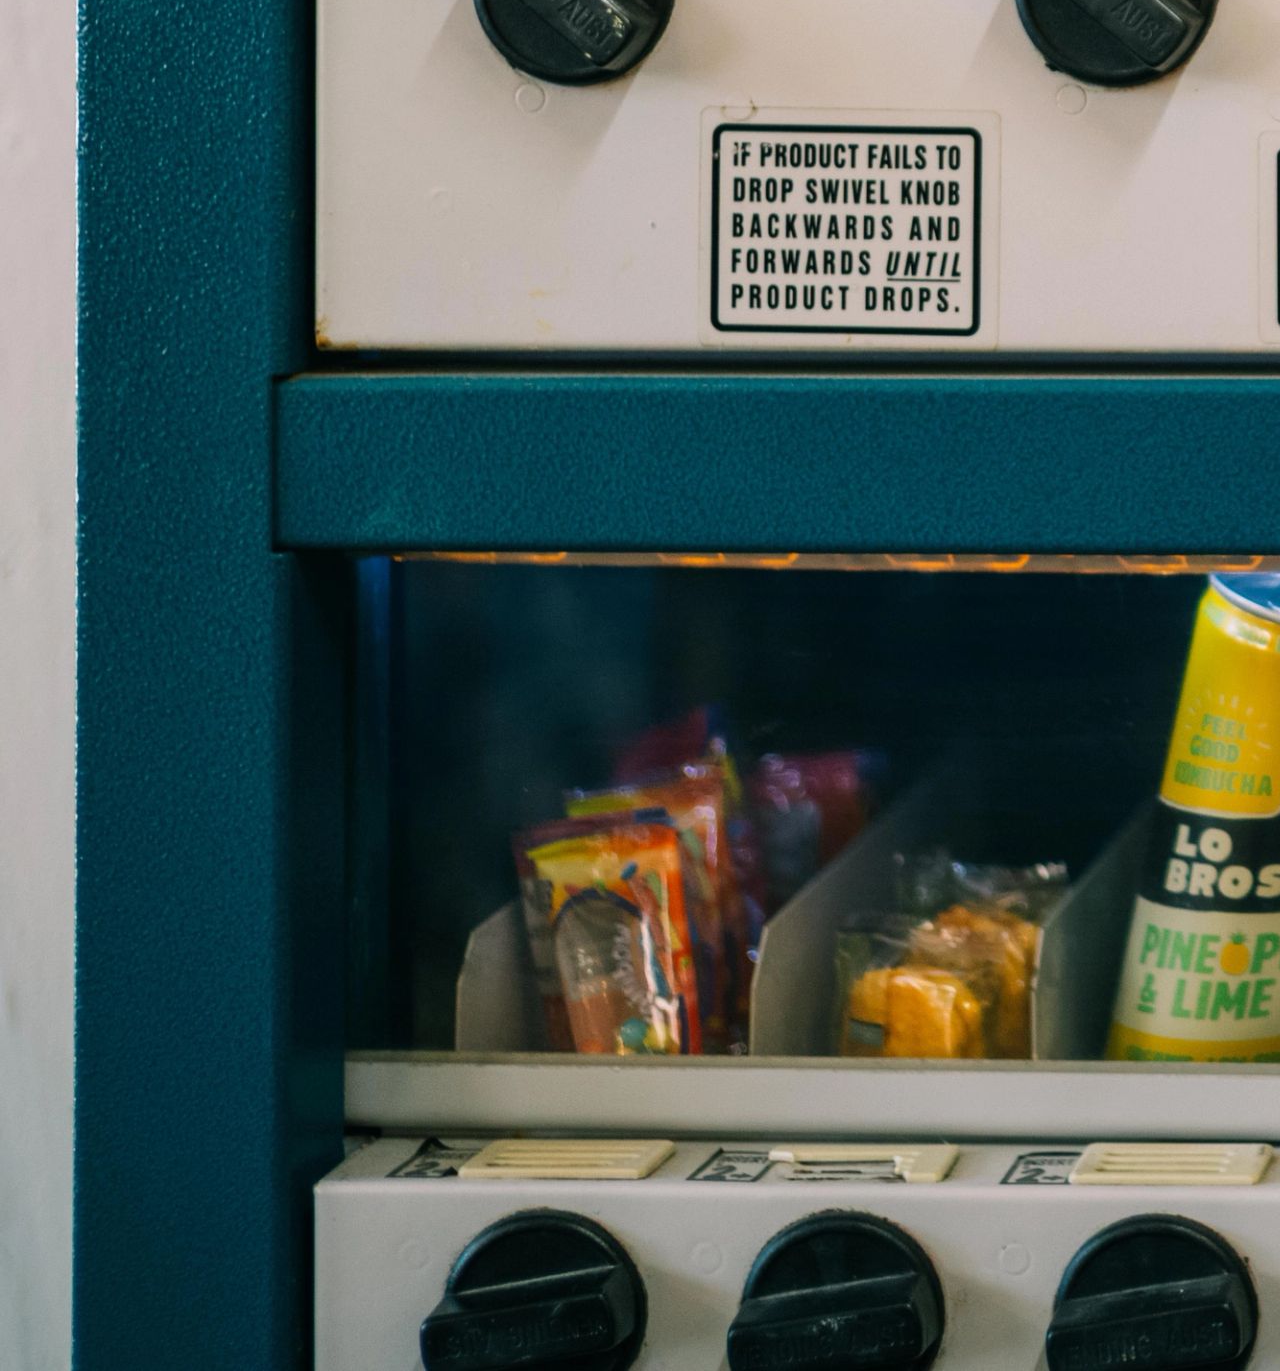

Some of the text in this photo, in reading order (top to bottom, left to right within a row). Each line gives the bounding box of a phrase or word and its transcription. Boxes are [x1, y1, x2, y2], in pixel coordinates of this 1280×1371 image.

[733, 141, 961, 171] IF PRODUCT FAILS TO
[733, 177, 960, 206] DROP SWIVEL KNOB
[732, 212, 960, 242] BACKWARDS AND
[731, 248, 961, 278] FORWARDS UNTIL
[731, 283, 960, 313] PRODUCT DROPS.
[1173, 824, 1233, 863] LO
[1171, 977, 1276, 1020] LIME
